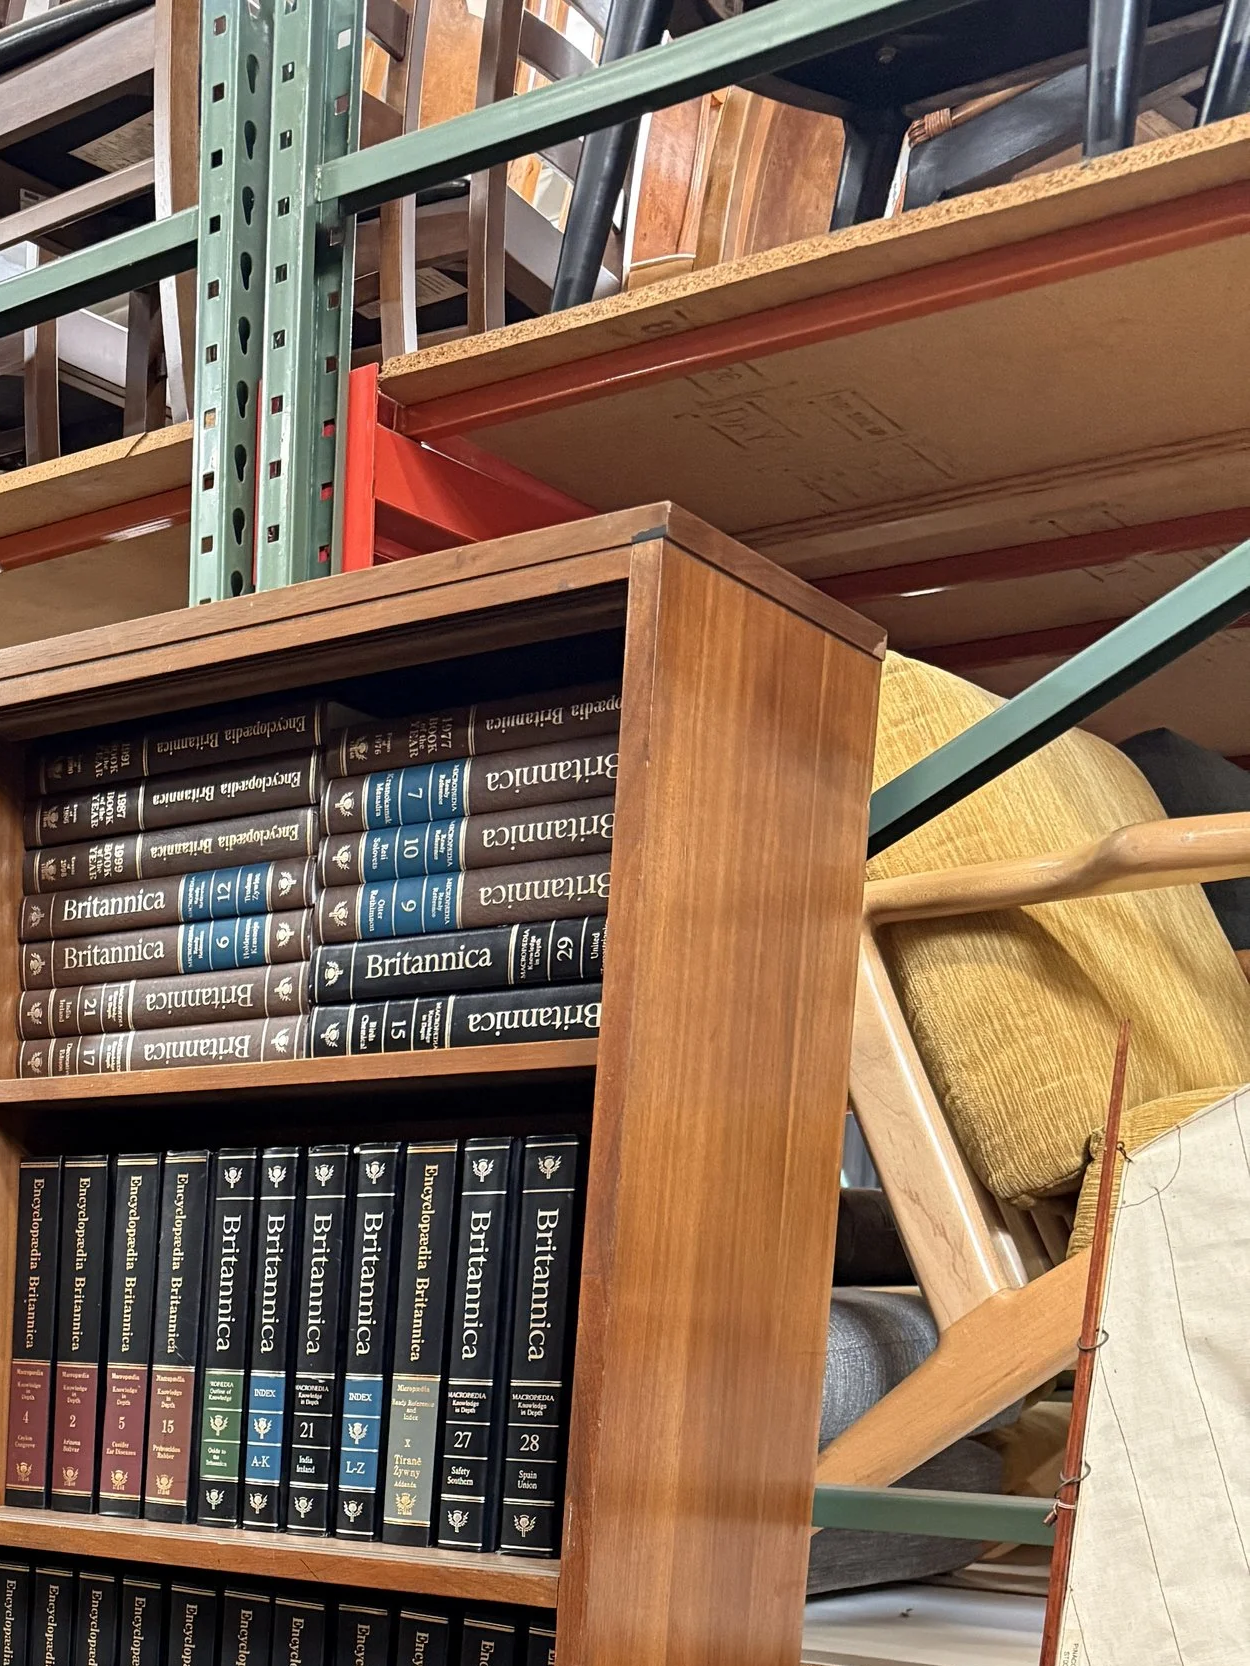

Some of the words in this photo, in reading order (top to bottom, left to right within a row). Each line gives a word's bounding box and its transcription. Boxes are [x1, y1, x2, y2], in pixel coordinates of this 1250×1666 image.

[486, 706, 564, 733] Britannica
[156, 732, 218, 755] Britannica
[486, 752, 619, 794] Britannica
[152, 785, 215, 808] Britannica
[408, 787, 423, 799] 7
[482, 813, 616, 851] Britannica
[150, 838, 212, 859] Britannica
[403, 838, 419, 859] 10
[217, 881, 232, 902] 12
[479, 871, 611, 910] Britannica
[62, 888, 166, 922] Britannica
[401, 899, 417, 912] 9
[216, 936, 230, 949] 6
[556, 936, 574, 961] 29
[63, 940, 165, 970] Britannica
[365, 945, 492, 980] Britannica
[83, 996, 97, 1018] 21
[145, 983, 254, 1015] Britannica
[391, 1020, 406, 1040] 15
[468, 1002, 603, 1037] Britannica
[83, 1048, 96, 1067] 17
[143, 1034, 251, 1064] Britannica
[216, 1214, 242, 1352] Britannica
[260, 1214, 286, 1353] Britannica
[305, 1213, 332, 1355] Britannica
[355, 1211, 384, 1356] Britannica
[462, 1210, 492, 1361] Britannica
[527, 1208, 560, 1362] Britannica
[25, 1276, 40, 1350] Britannica
[71, 1277, 86, 1352] Britannica
[122, 1276, 137, 1353] Britannica
[167, 1276, 184, 1354] Britannica
[410, 1277, 430, 1361] Britannica
[254, 1388, 276, 1398] INDEX
[348, 1392, 372, 1402] INDEX
[22, 1410, 29, 1423] 4
[69, 1414, 76, 1427] 2
[118, 1416, 125, 1430] 5
[161, 1420, 175, 1434] 15
[299, 1421, 314, 1439] 21
[453, 1431, 472, 1449] 27
[519, 1434, 540, 1451] 28
[251, 1455, 271, 1468] A-K
[345, 1460, 366, 1474] L-Z
[451, 1466, 470, 1477] Safety
[517, 1480, 537, 1490] Union
[518, 1470, 537, 1480] Spain
